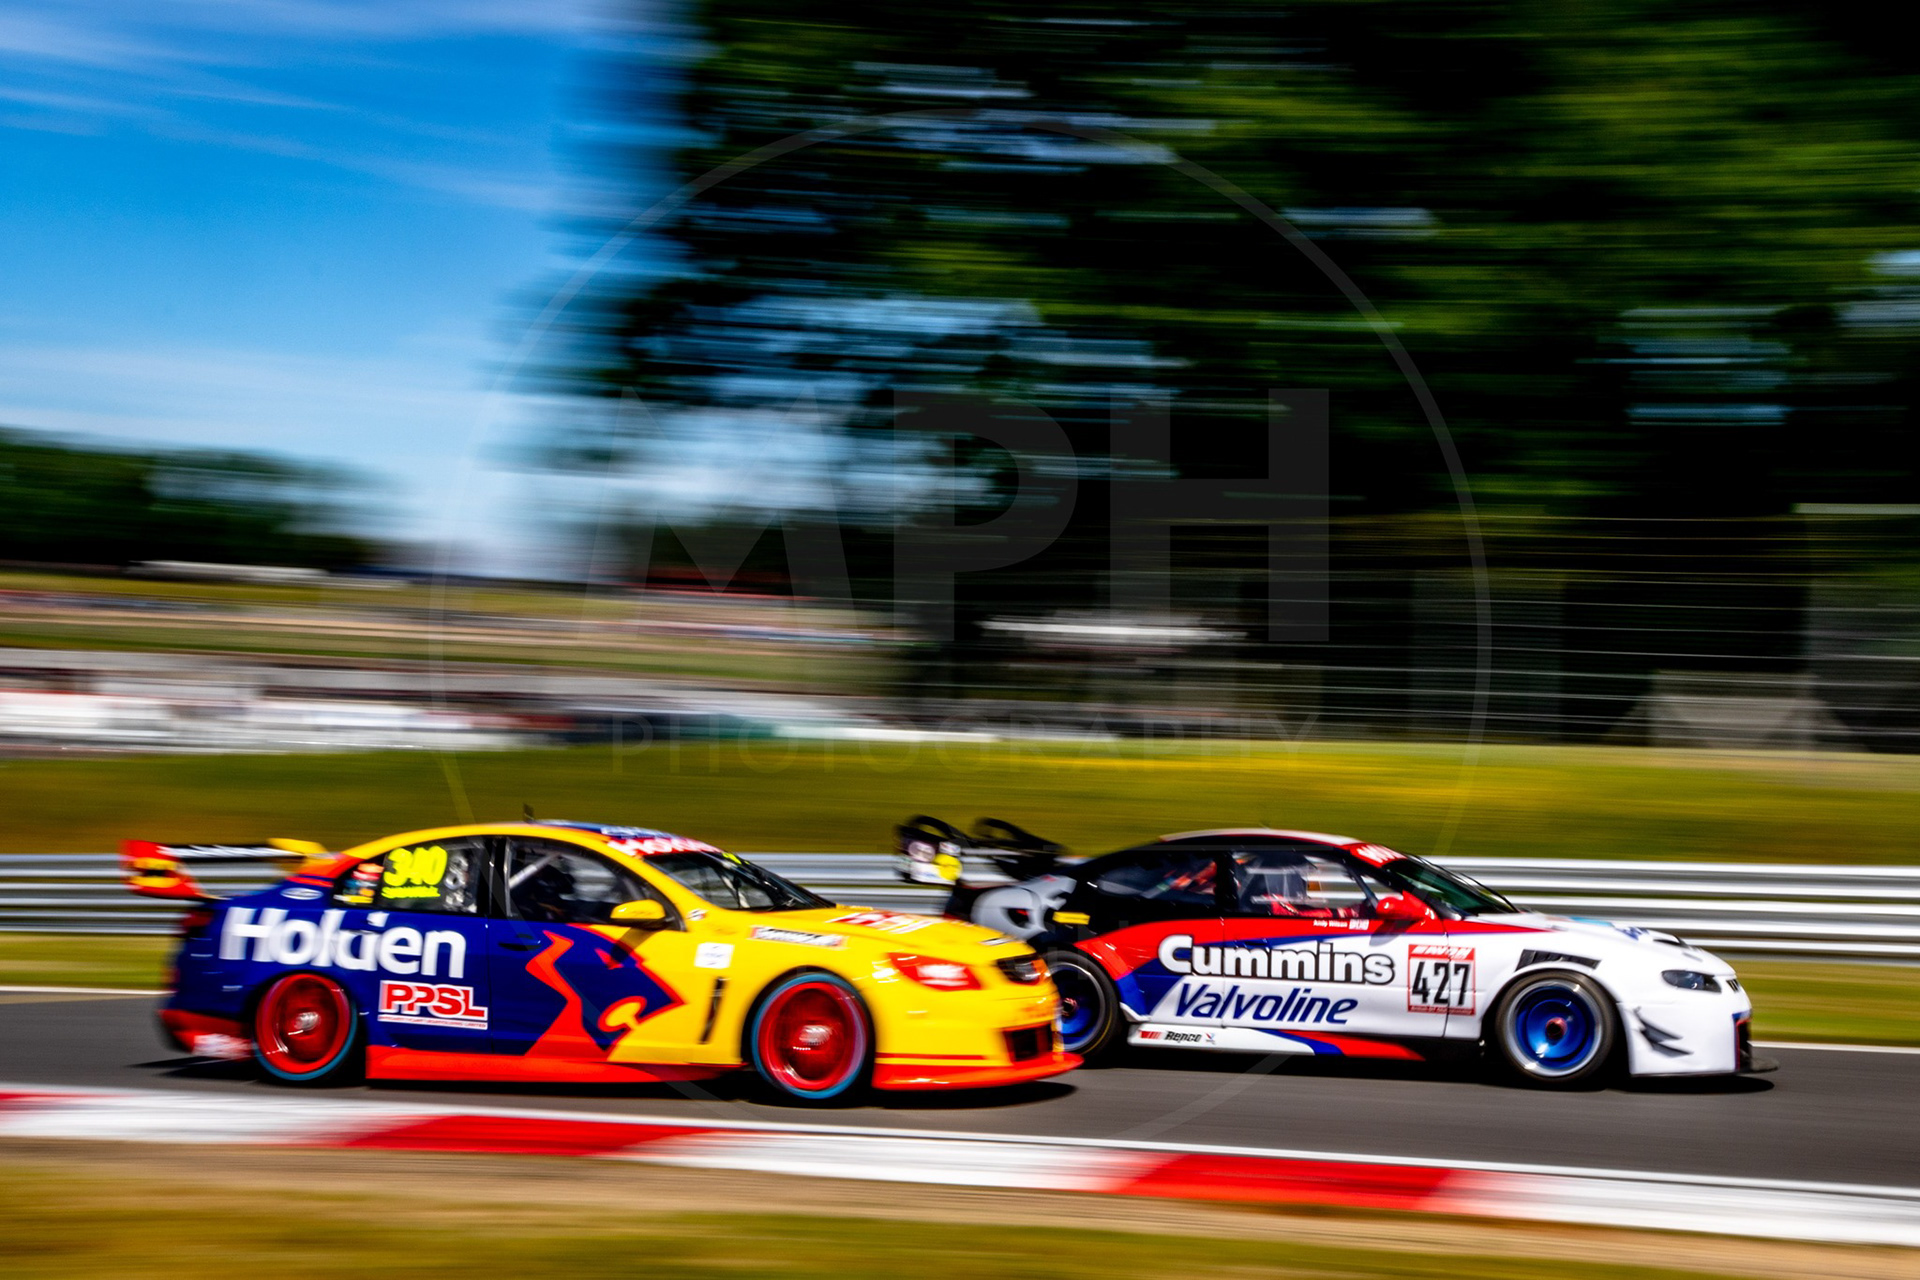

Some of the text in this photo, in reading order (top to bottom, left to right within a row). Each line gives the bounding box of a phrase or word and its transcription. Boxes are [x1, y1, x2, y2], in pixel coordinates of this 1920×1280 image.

[383, 846, 447, 886] 340
[1158, 934, 1396, 986] Cummins
[380, 981, 487, 1020] PPSL
[1174, 983, 1358, 1025] Valvoline
[1411, 961, 1470, 1006] 427
[1164, 1030, 1202, 1043] Repco
